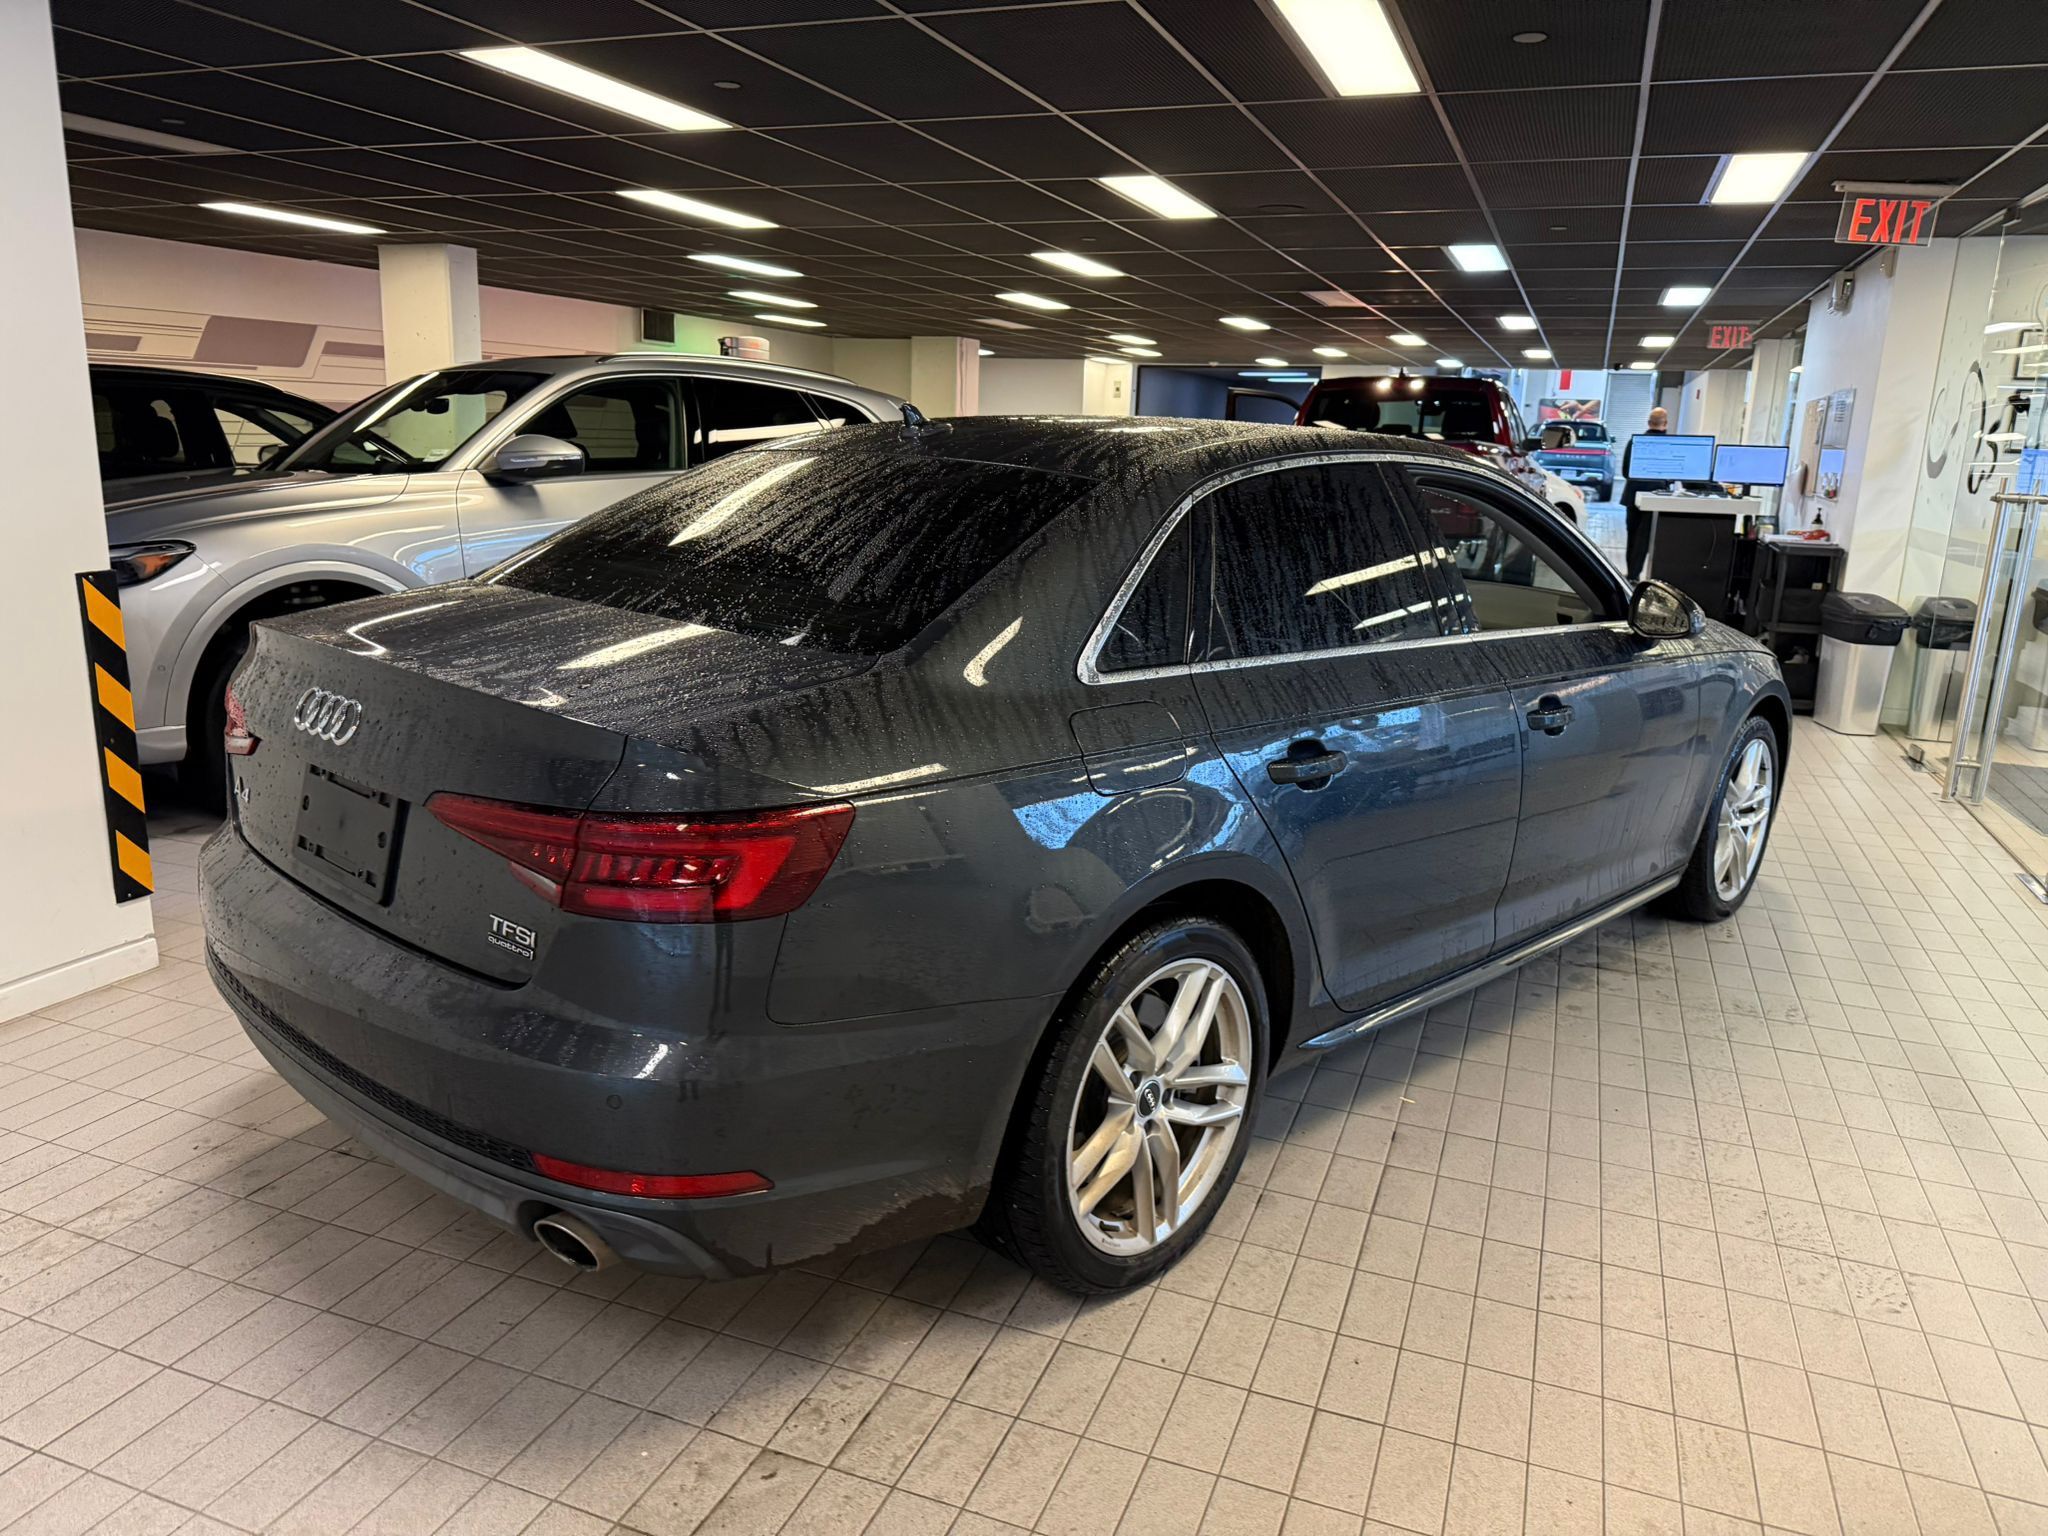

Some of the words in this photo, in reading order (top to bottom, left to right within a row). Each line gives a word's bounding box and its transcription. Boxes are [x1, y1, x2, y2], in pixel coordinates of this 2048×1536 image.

[1848, 198, 1931, 243] EXIT
[1711, 326, 1749, 348] EXIT
[234, 776, 249, 803] A4
[489, 914, 536, 948] TFSI
[488, 935, 530, 957] quattro
